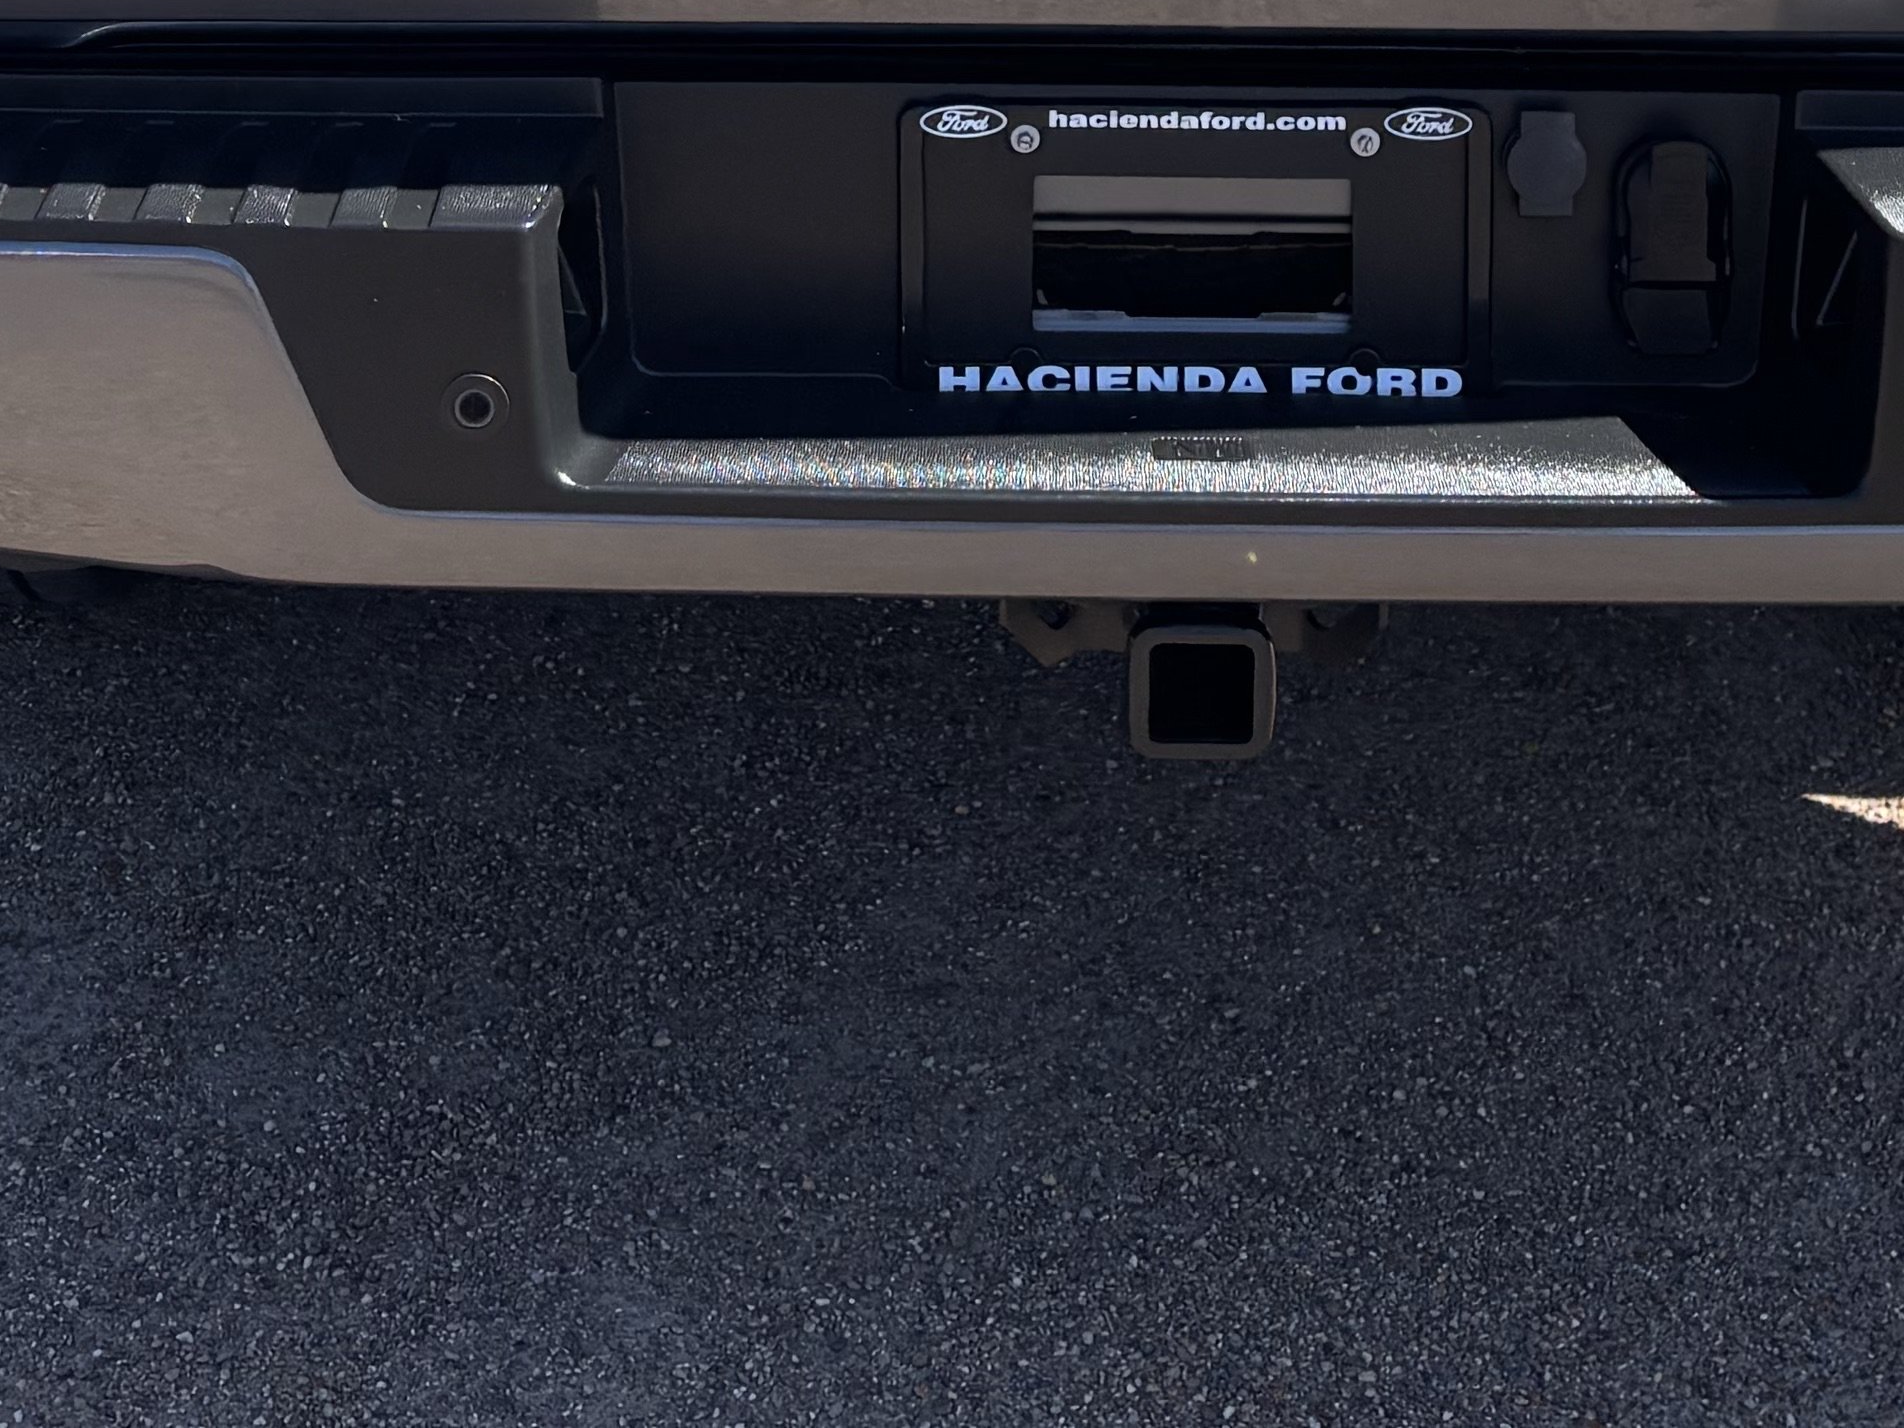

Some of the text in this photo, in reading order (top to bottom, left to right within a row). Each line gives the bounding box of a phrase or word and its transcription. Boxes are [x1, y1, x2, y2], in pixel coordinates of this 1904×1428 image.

[936, 112, 992, 132] Ford
[1048, 109, 1348, 132] haciendaford.com
[1400, 114, 1455, 135] Ford
[938, 365, 1464, 397] HACIENDA FORD
